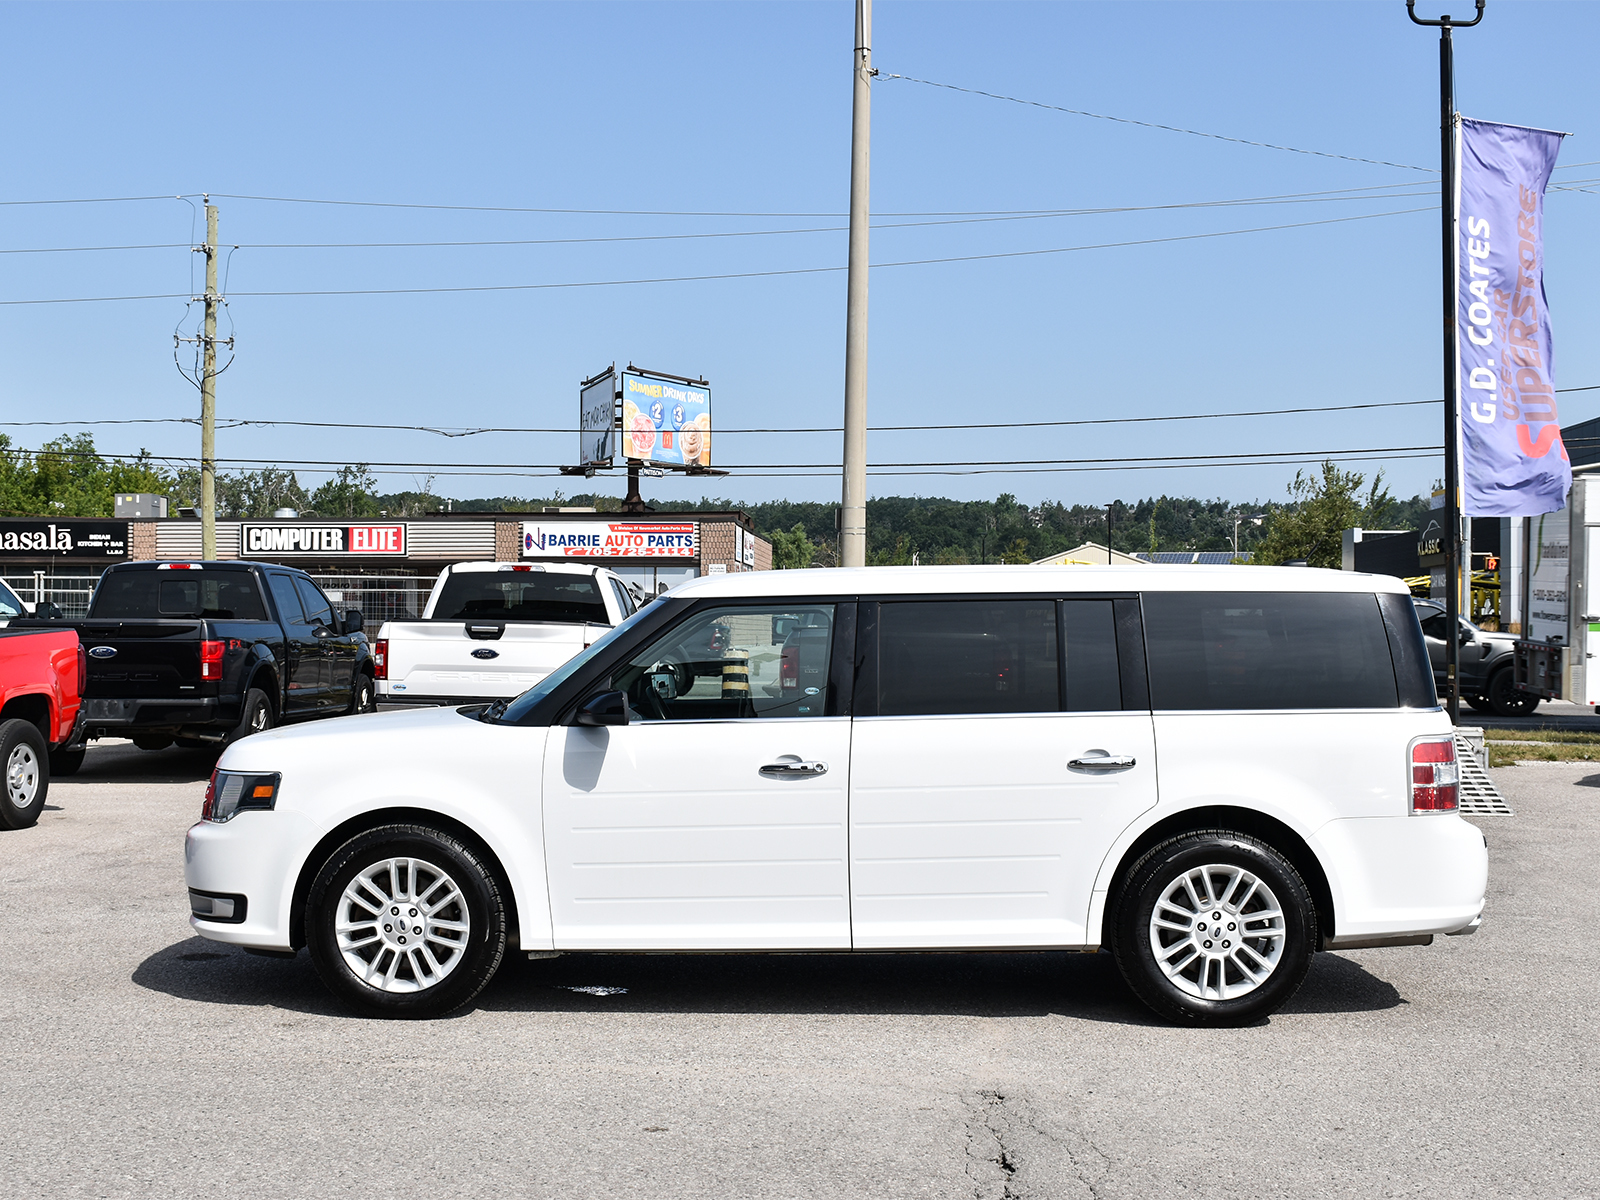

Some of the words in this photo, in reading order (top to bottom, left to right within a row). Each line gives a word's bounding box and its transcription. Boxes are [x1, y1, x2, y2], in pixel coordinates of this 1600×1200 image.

[1467, 215, 1493, 347] COATES
[1494, 287, 1512, 342] CAR
[1508, 183, 1568, 462] SUPERSTORE
[629, 379, 663, 398] SUMMER
[663, 385, 687, 403] DRINK
[687, 391, 705, 404] DAYS
[1470, 358, 1496, 425] G.D.
[1501, 347, 1520, 422] USED
[250, 528, 343, 551] COMPUTER
[353, 528, 398, 551] ELITE
[549, 534, 600, 547] BARRIE
[605, 534, 644, 547] AUTO
[648, 534, 693, 547] PARTS
